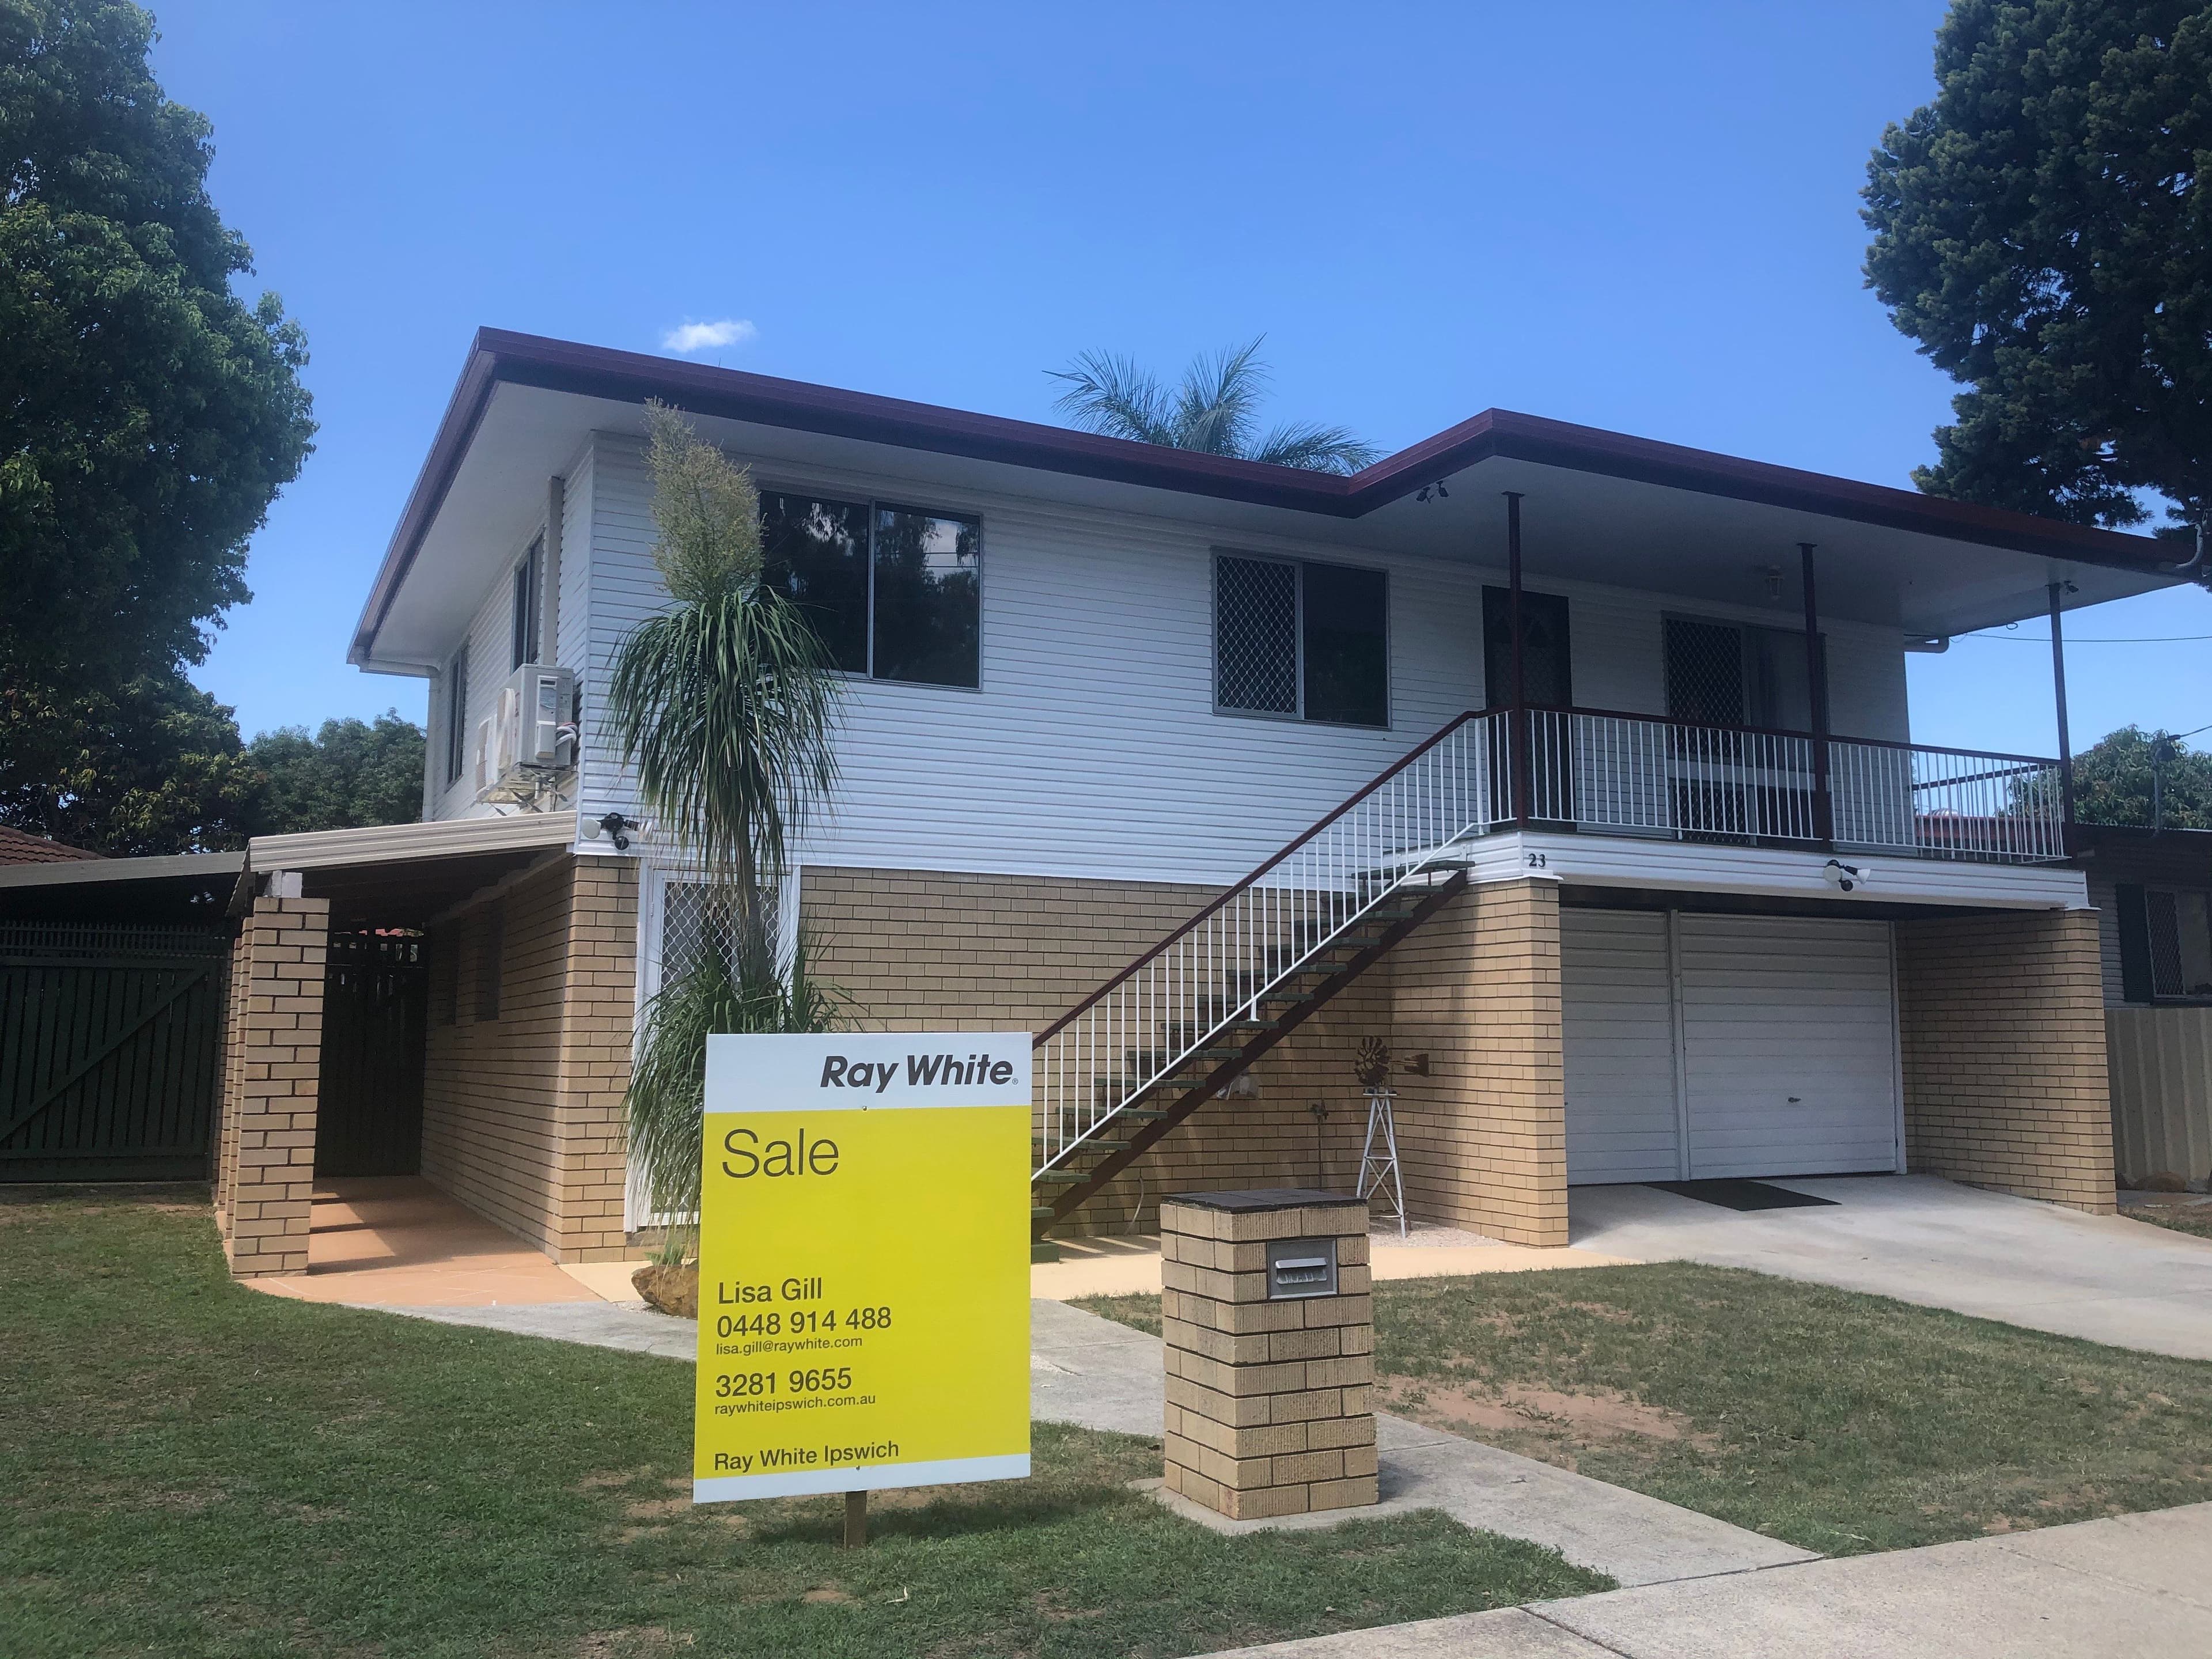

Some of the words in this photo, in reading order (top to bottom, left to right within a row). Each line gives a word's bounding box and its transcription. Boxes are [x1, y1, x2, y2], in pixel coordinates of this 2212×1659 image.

[1528, 853, 1546, 868] 23
[820, 1055, 900, 1093] Ray
[907, 1054, 1013, 1086] White
[722, 1128, 839, 1179] Sale
[718, 1282, 772, 1304] Lisa
[781, 1277, 823, 1301] Gill
[717, 1313, 781, 1338] 0448
[790, 1310, 837, 1333] 914
[845, 1306, 892, 1330] 488
[715, 1336, 862, 1356] lisa.gill@raywhite.com
[715, 1372, 776, 1397] 3281
[789, 1368, 852, 1393] 9655
[714, 1393, 876, 1416] raywhiteipswich.com.au
[714, 1452, 753, 1473] Ray
[760, 1448, 817, 1467] White
[824, 1441, 900, 1466] Ipswich
